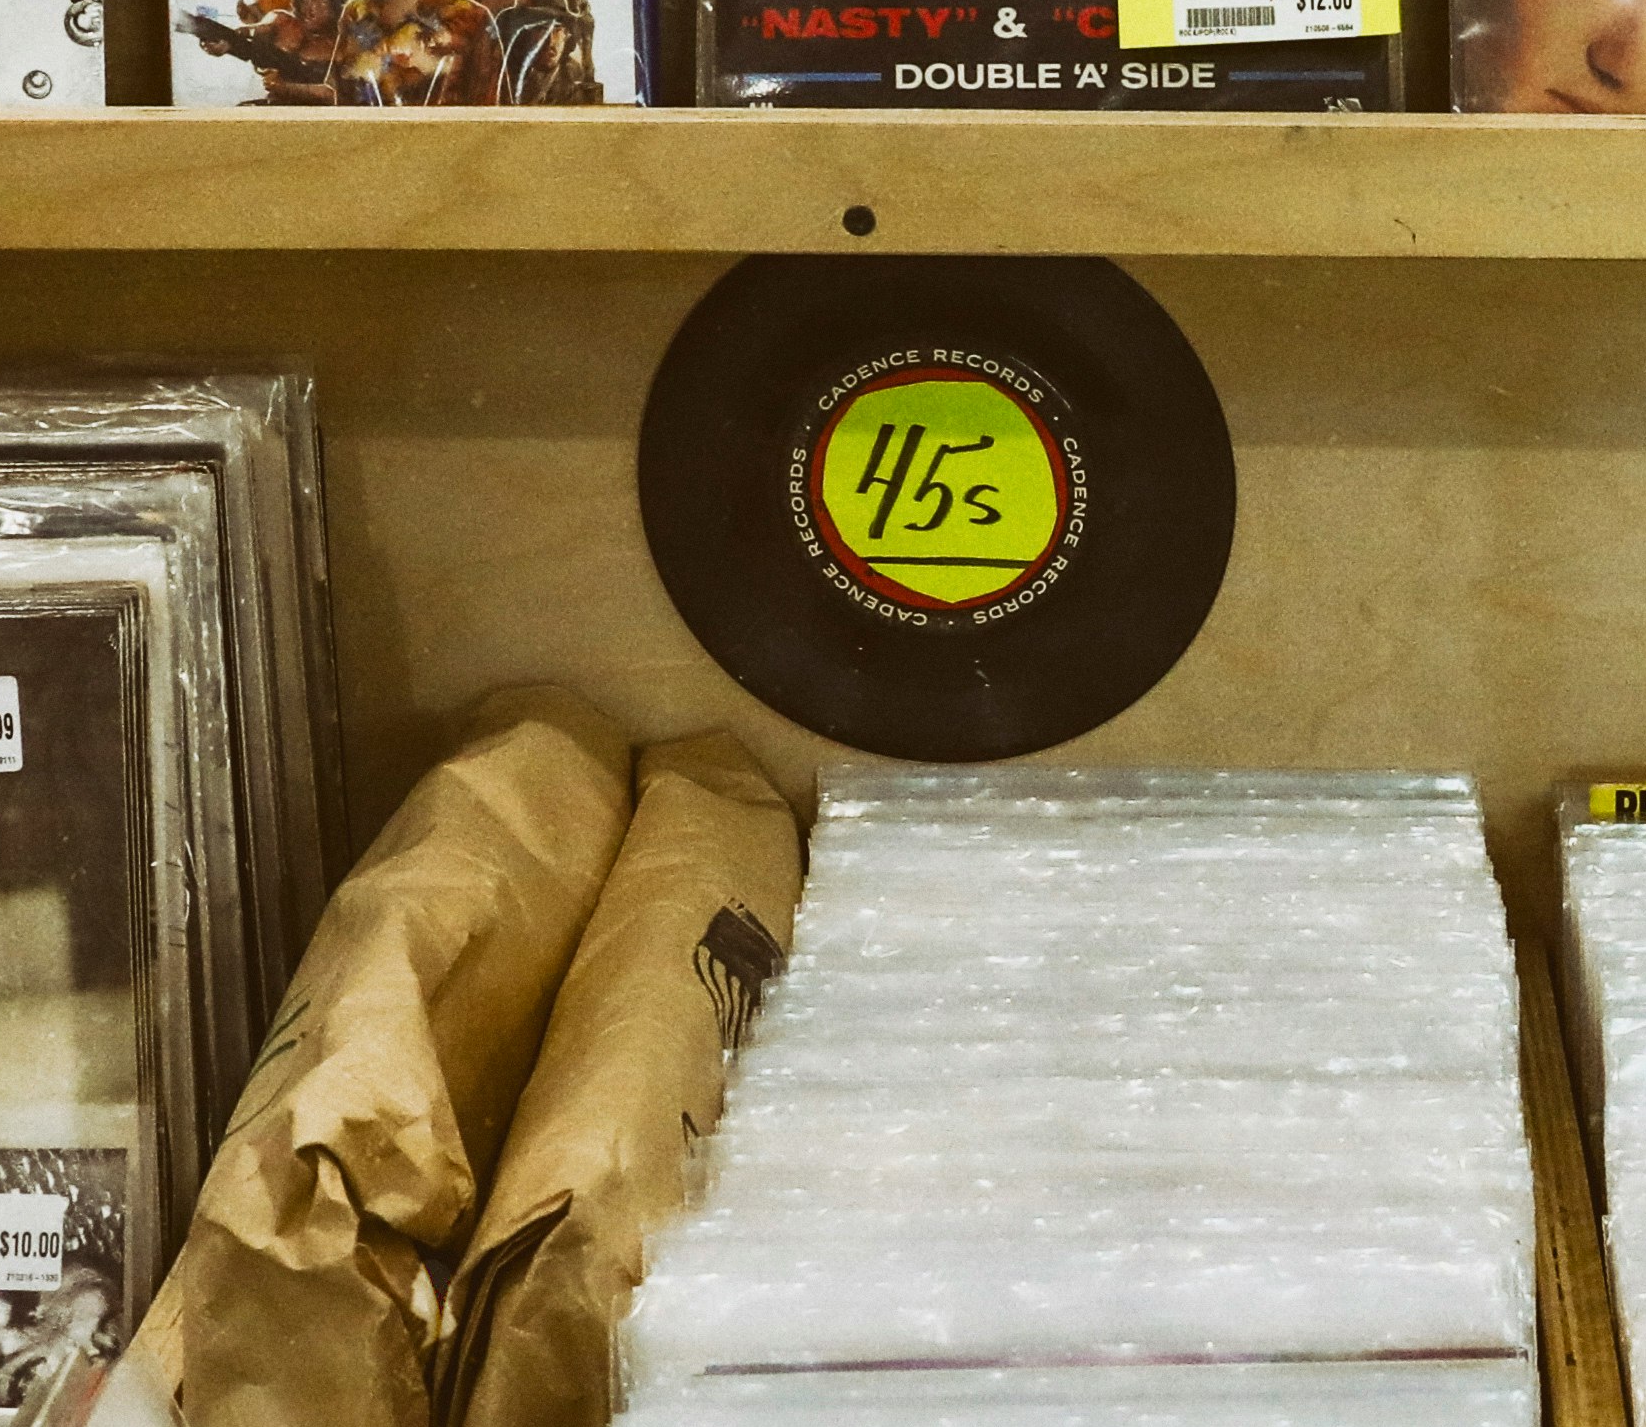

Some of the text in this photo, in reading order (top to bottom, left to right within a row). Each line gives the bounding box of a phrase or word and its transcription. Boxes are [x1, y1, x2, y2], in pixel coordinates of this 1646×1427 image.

[992, 6, 1027, 39] &
[894, 63, 1061, 90] DOUBLE
[1120, 64, 1216, 89] SIDE
[817, 348, 1045, 412] CADENCE RECORDS
[855, 422, 1002, 539] 45s
[789, 446, 928, 627] CADENCE RECORDS
[972, 436, 1087, 626] CADENCE RECORDS
[0, 1231, 60, 1258] $10.00
